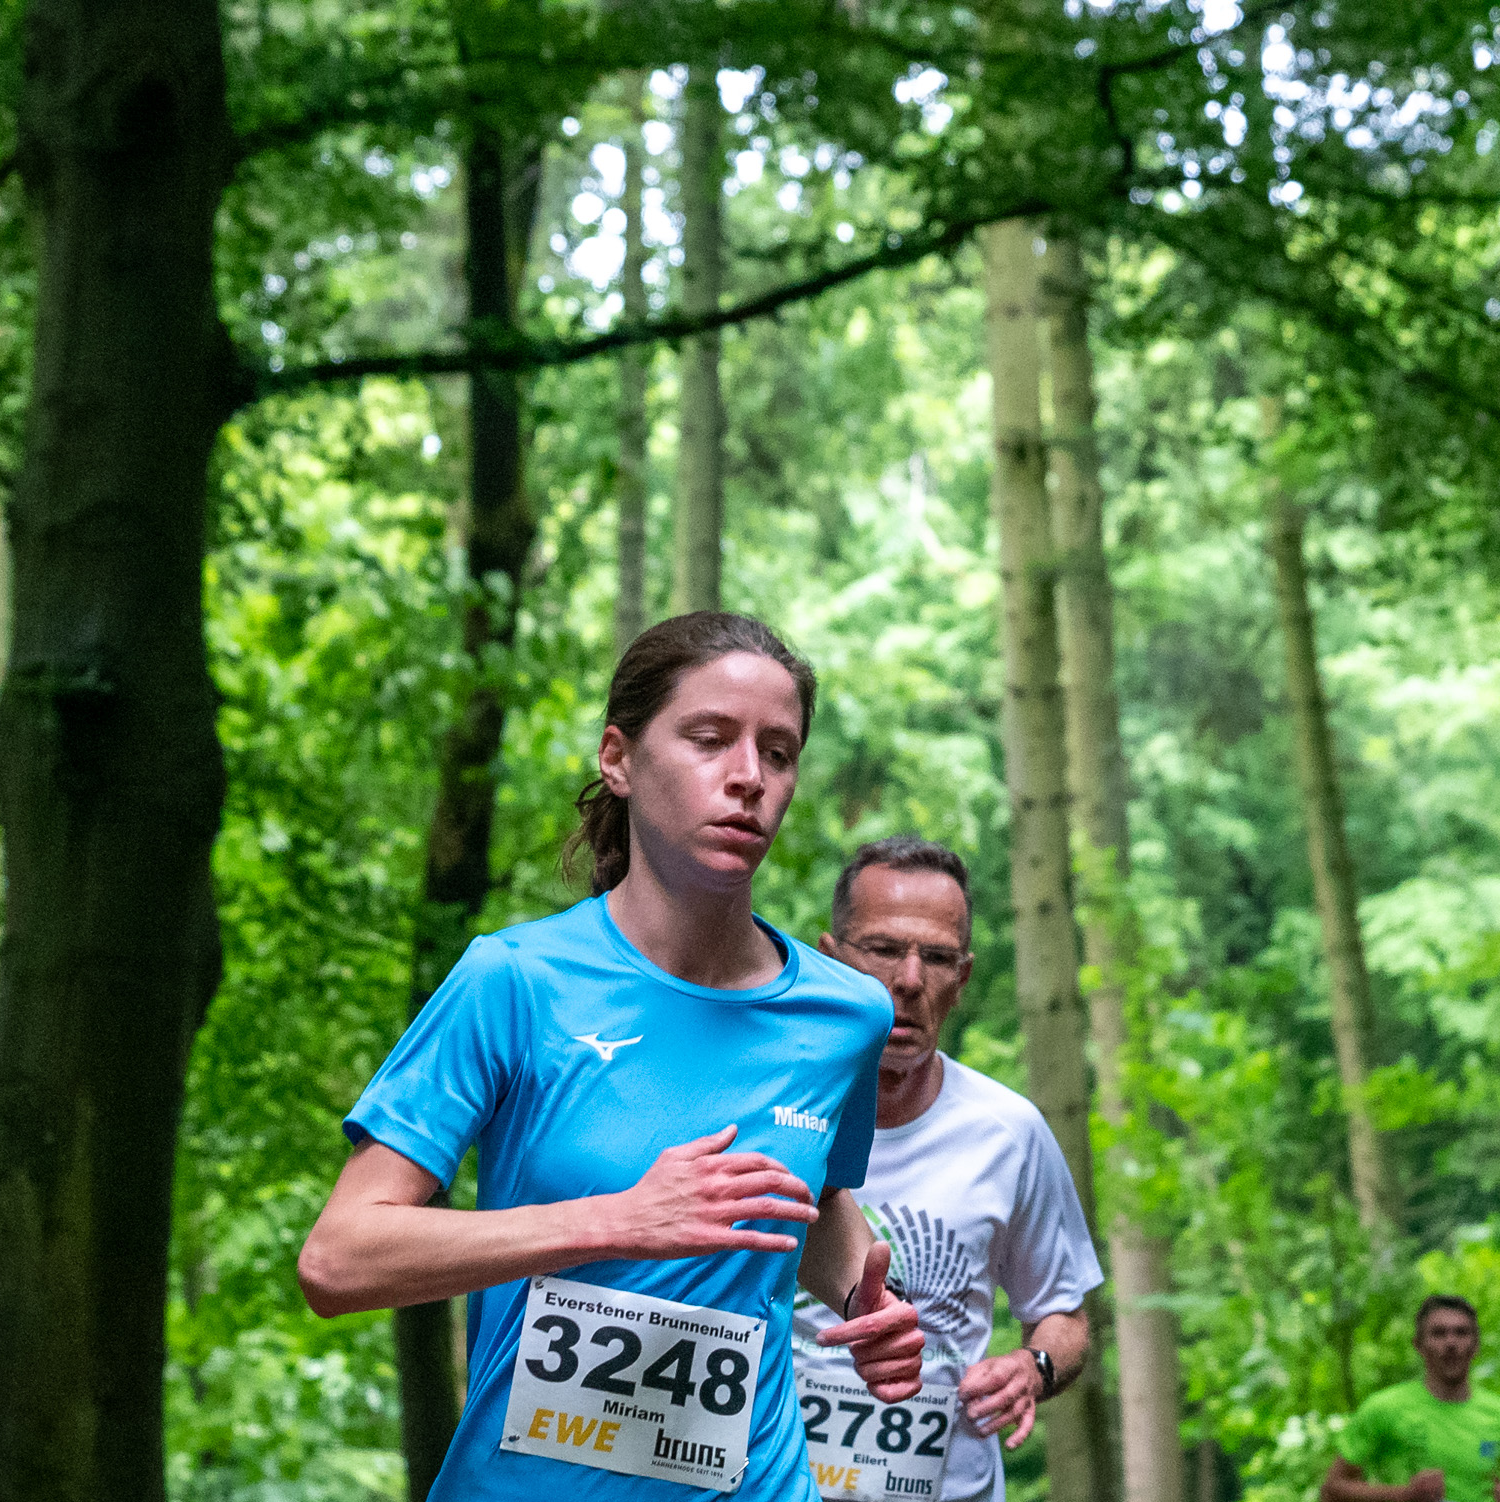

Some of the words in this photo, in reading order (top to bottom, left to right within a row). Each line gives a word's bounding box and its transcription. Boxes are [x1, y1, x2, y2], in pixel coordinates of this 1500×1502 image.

[545, 1291, 644, 1322] Everstener
[649, 1311, 751, 1343] Brunnenlauf
[525, 1315, 750, 1416] 3248
[603, 1399, 665, 1424] Miriam
[910, 1395, 949, 1405] enlauf
[527, 1408, 621, 1453] EWE
[799, 1395, 948, 1458] 2782
[654, 1428, 726, 1469] bruns
[853, 1453, 888, 1467] Eilert
[809, 1461, 861, 1490] WE
[885, 1470, 933, 1495] bruns
